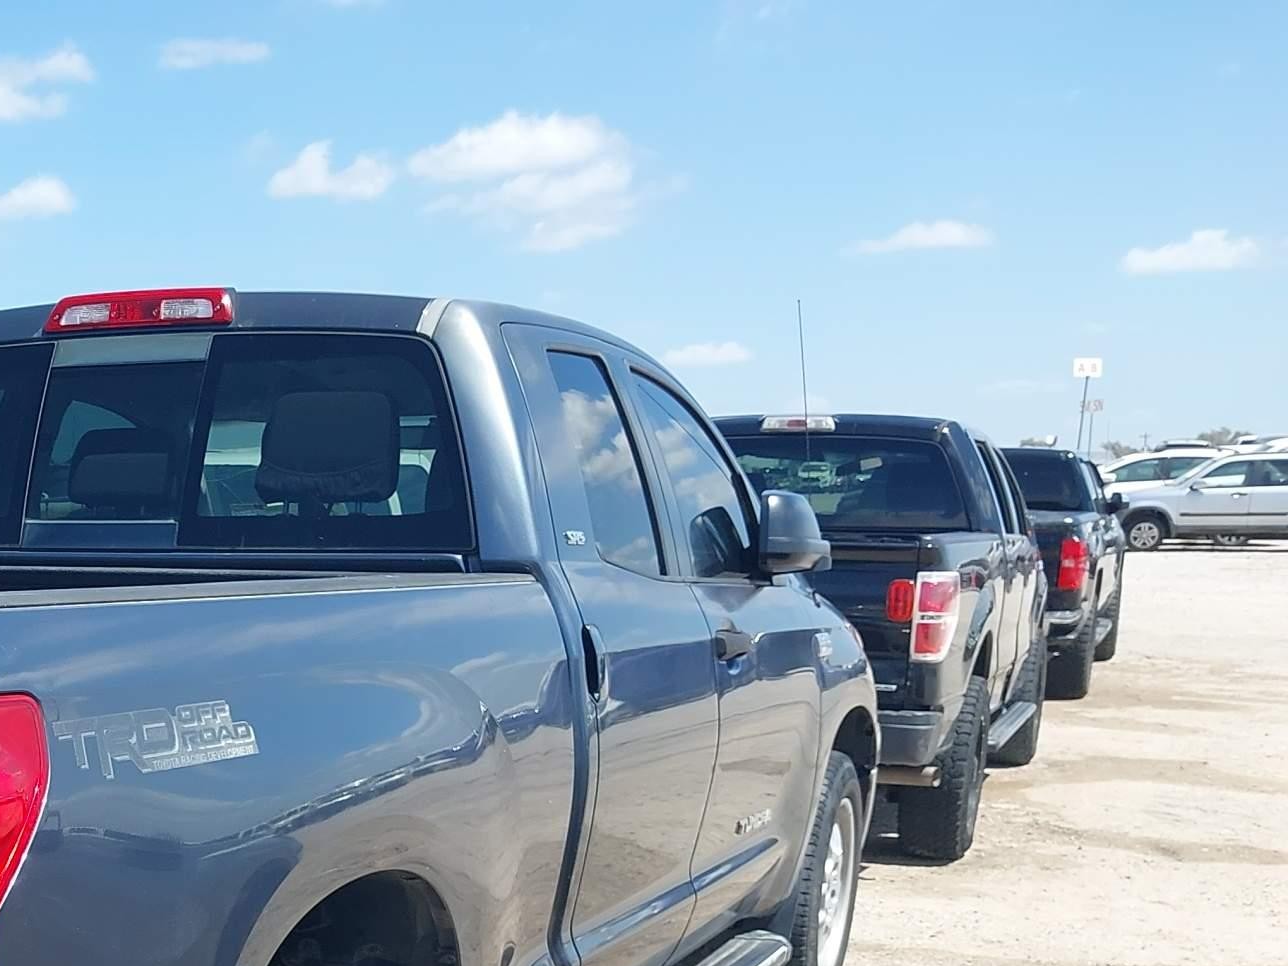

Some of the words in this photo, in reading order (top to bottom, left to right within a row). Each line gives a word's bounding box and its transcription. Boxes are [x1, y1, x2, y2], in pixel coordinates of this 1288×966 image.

[52, 707, 180, 780] TRD
[176, 700, 232, 728] OFF
[181, 721, 255, 752] ROAD
